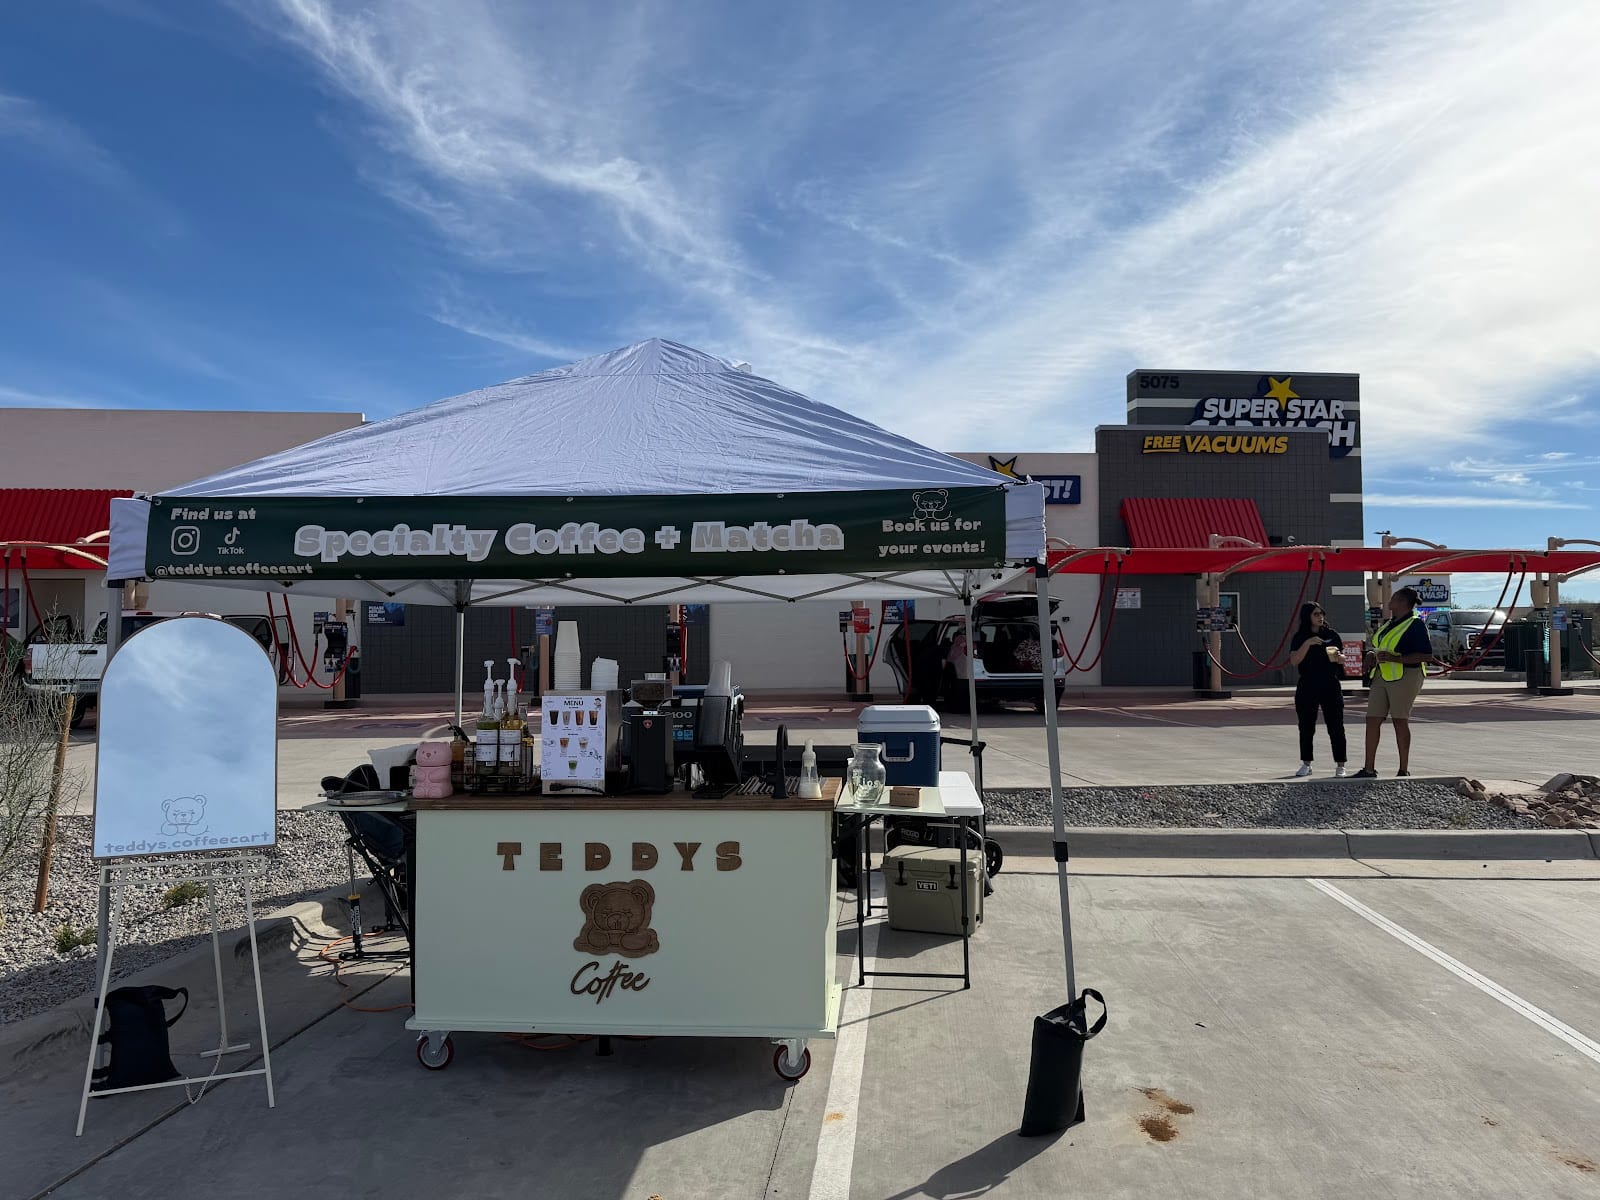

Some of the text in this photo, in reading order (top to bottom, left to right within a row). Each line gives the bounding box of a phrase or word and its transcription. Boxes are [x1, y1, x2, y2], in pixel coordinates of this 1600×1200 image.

[1140, 375, 1180, 389] 5075
[1203, 397, 1345, 420] SUPER STAR
[1143, 435, 1288, 454] FREE VACUUMS
[171, 507, 256, 520] Find us at
[882, 518, 982, 532] Book us for
[294, 519, 844, 562] Specialty Coffee + Matcha
[217, 546, 244, 555] TikTok
[878, 540, 986, 558] your events!
[155, 563, 314, 577] @teddys.coffeecart
[1422, 591, 1448, 599] WASH
[104, 832, 270, 854] teddys.coffeecart
[497, 841, 742, 871] TEDDYS
[918, 881, 937, 890] YETI
[570, 960, 650, 1005] Coffee
